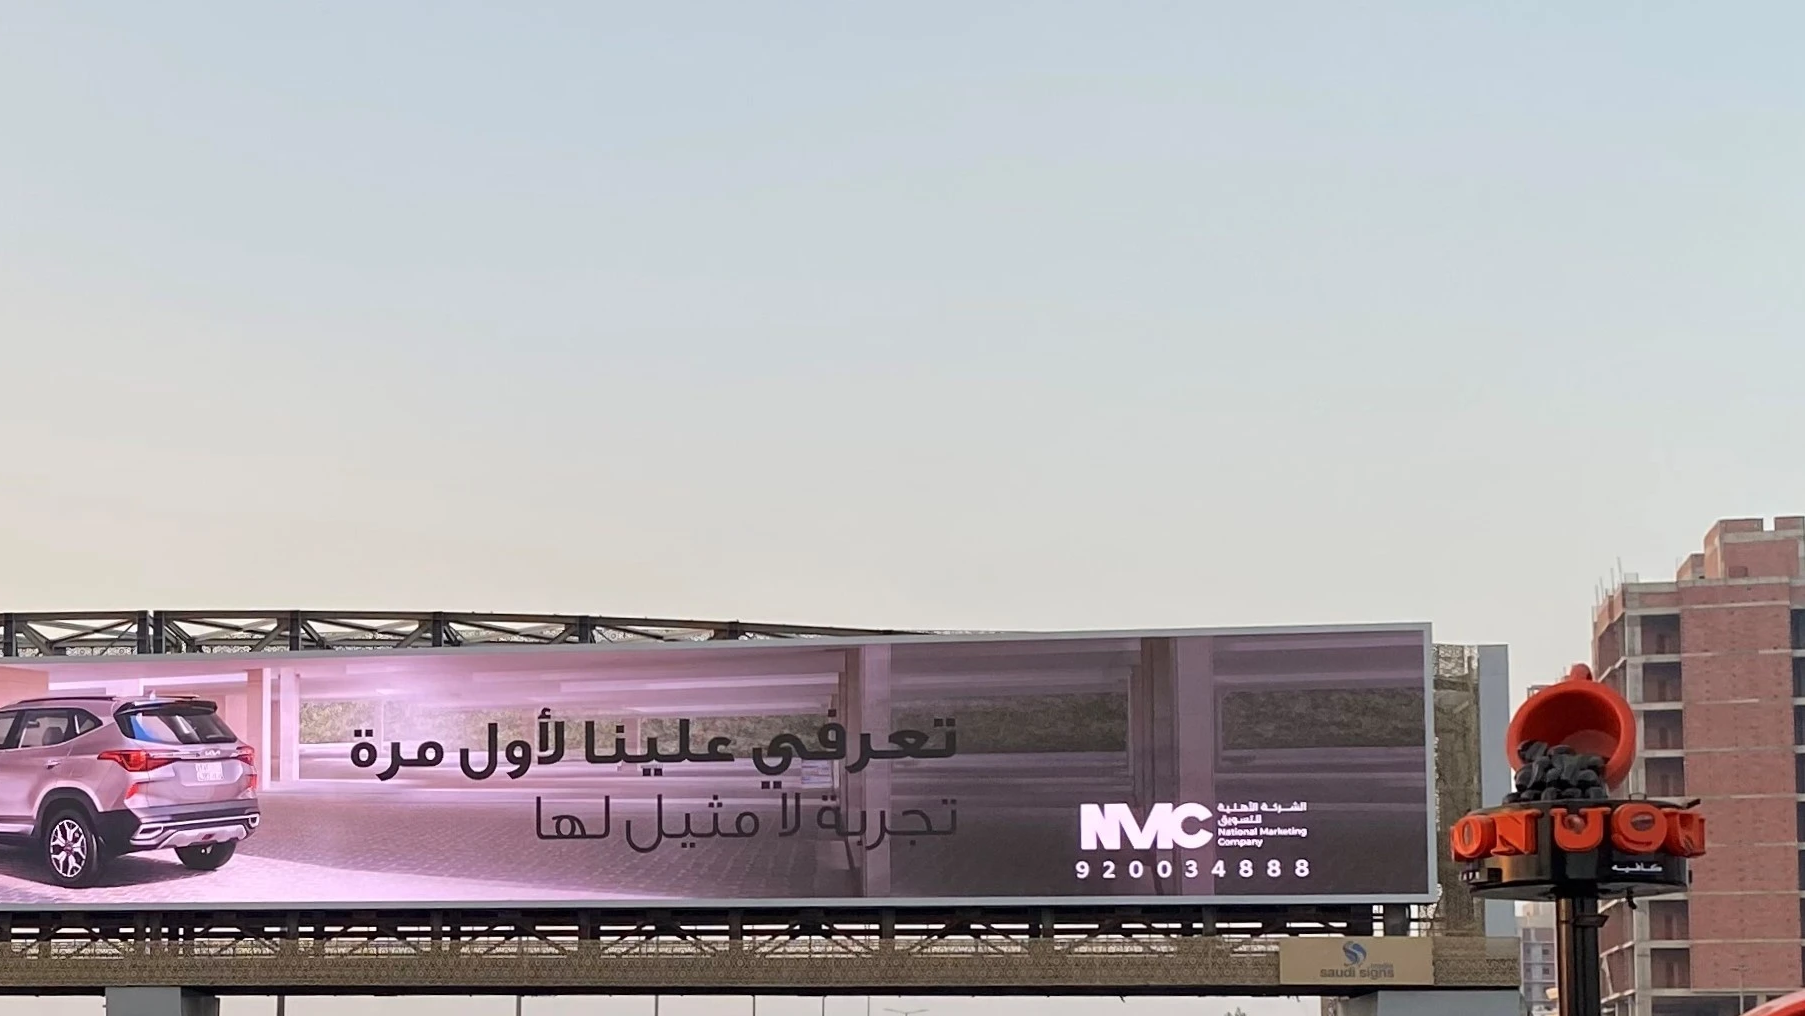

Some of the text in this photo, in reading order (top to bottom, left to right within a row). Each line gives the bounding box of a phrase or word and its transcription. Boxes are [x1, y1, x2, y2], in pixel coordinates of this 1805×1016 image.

[350, 707, 957, 789] تعرفي علينا لأول مرة
[536, 792, 957, 853] تجربة لا مثيل لها
[1080, 802, 1214, 850] NMC
[1217, 827, 1308, 838] National Marketing
[1217, 837, 1264, 848] Company
[1075, 859, 1311, 879] 920034888
[1319, 966, 1395, 981] saudi signs
